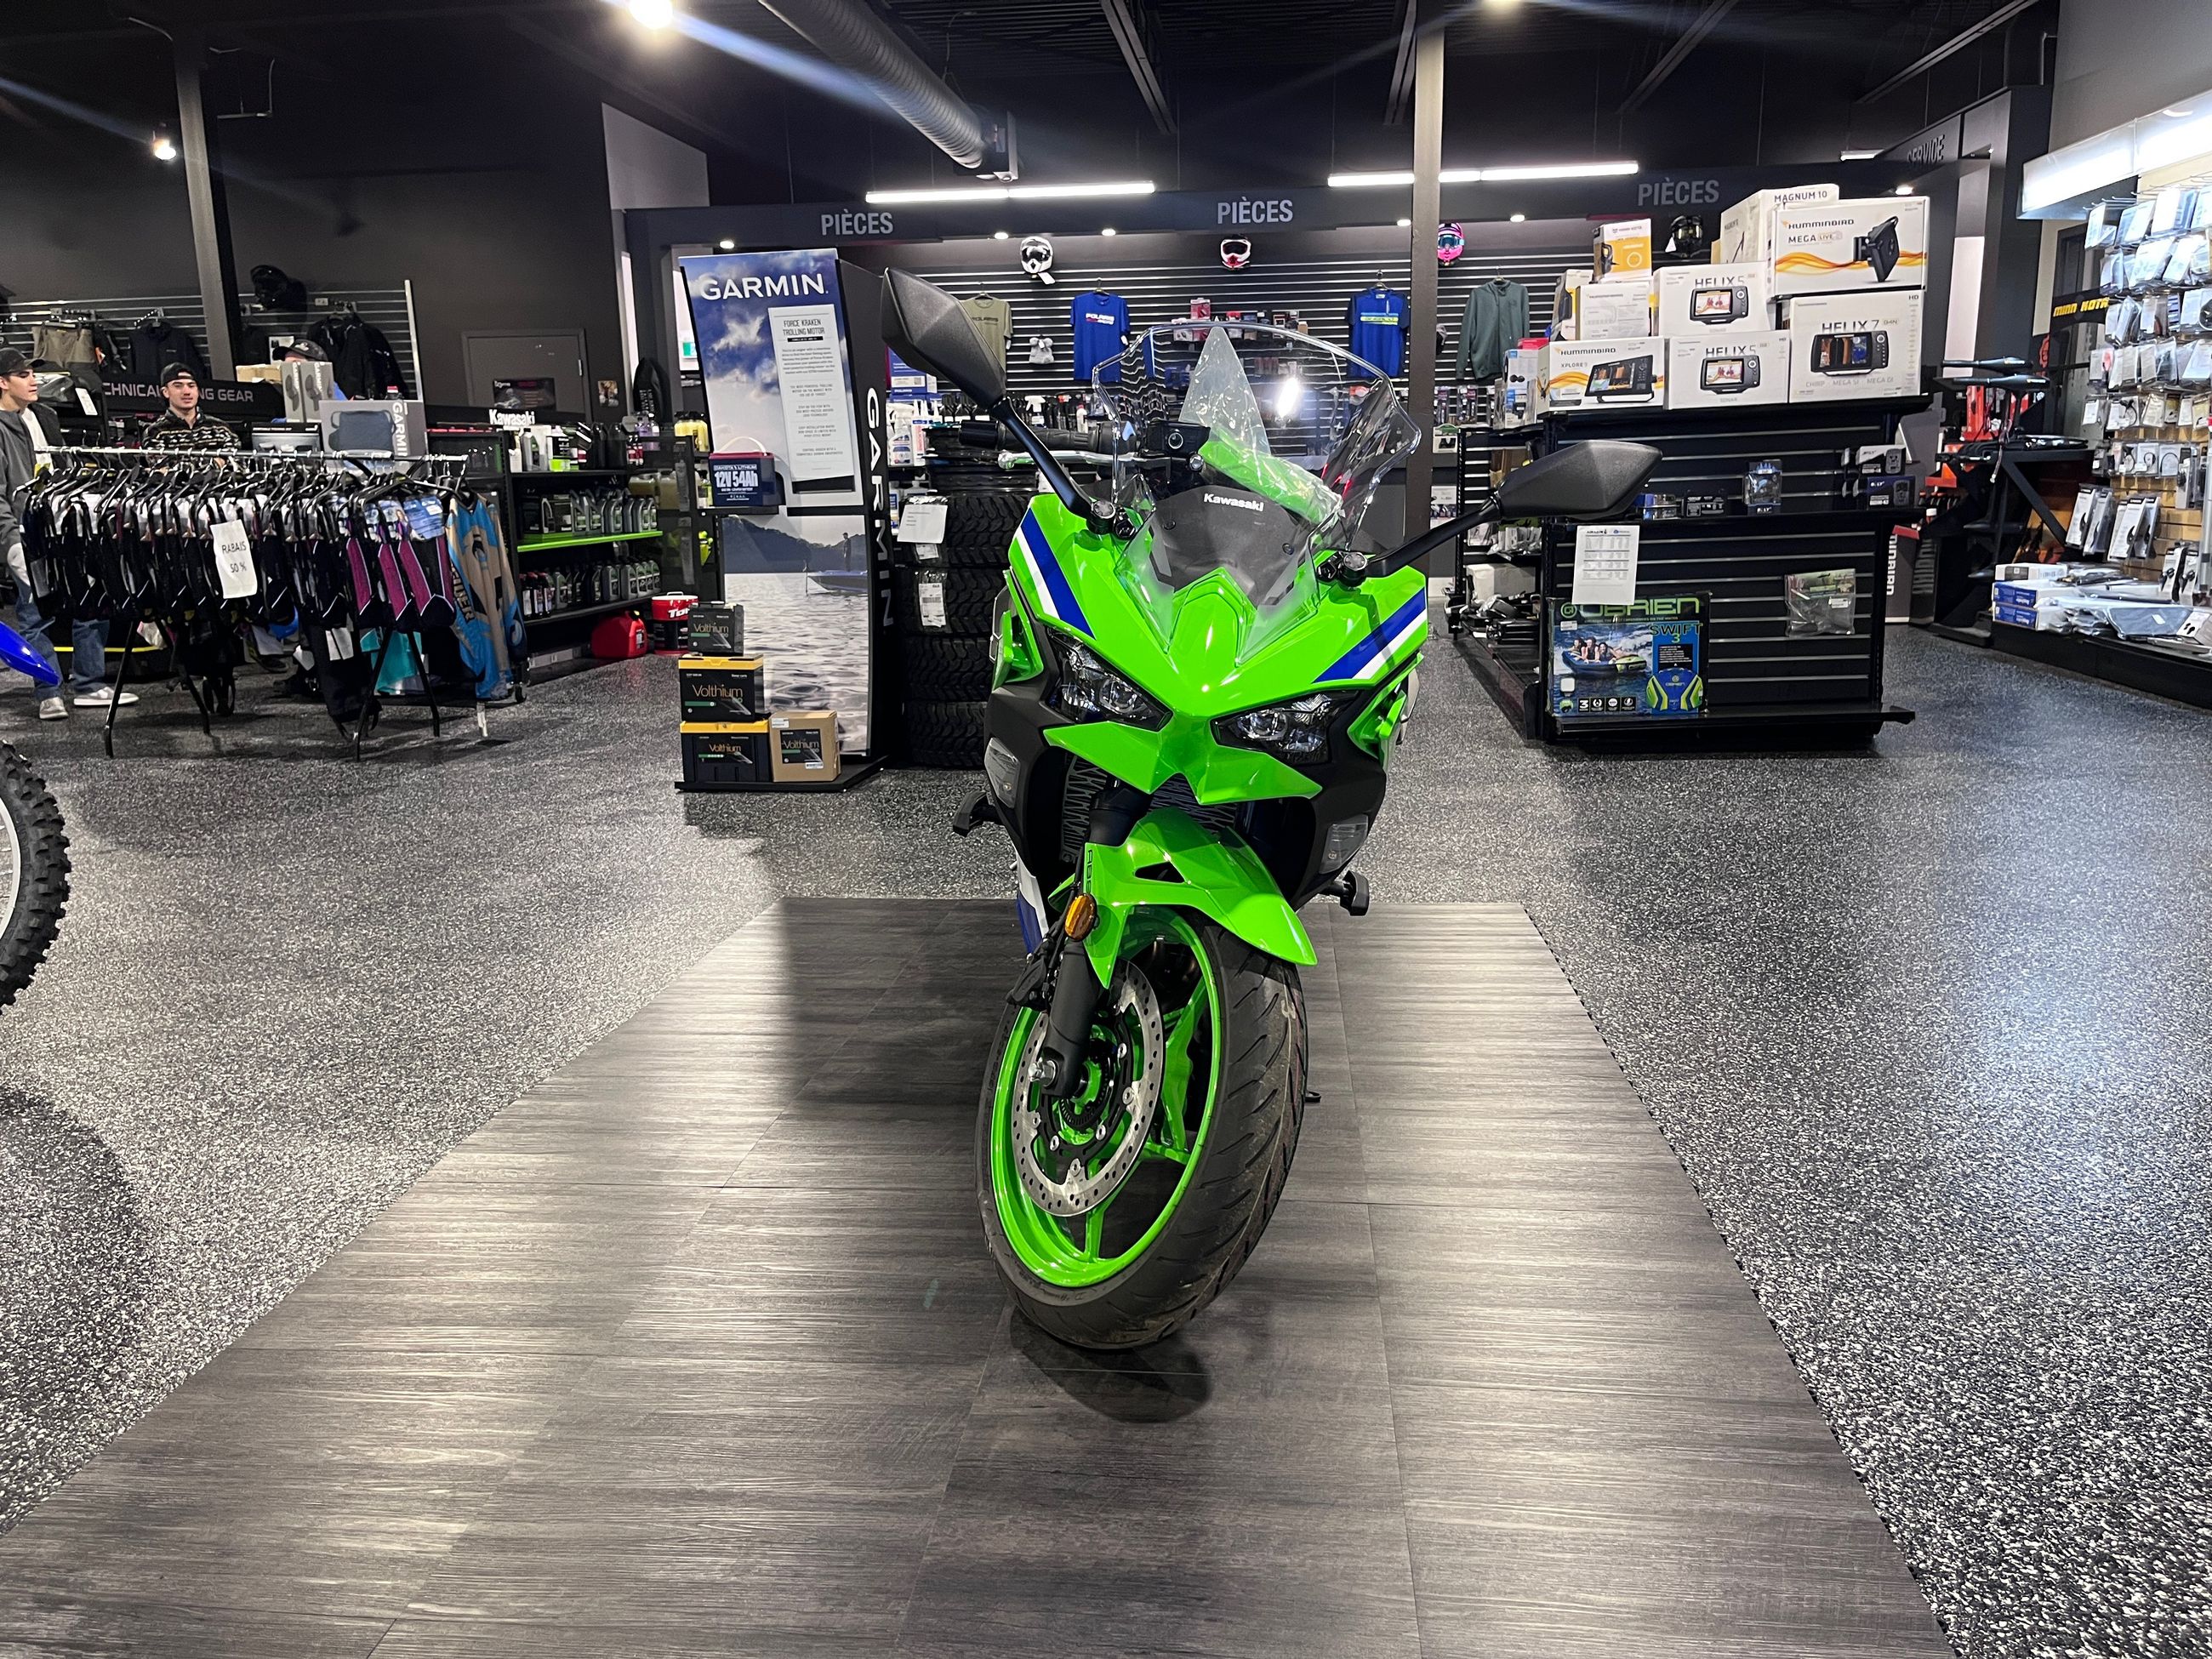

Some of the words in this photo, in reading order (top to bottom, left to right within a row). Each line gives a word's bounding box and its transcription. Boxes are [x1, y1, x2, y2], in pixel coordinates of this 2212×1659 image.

[1638, 177, 1719, 206] PIÈCES
[1775, 191, 1816, 203] MAGNUM
[1818, 191, 1827, 199] 10
[1217, 196, 1293, 224] PIÈCES
[821, 208, 893, 236] PIÈCES
[1788, 219, 1855, 229] HUMMINBIRD
[1787, 235, 1816, 244] MEGA
[699, 273, 825, 300] GARMIN
[801, 318, 822, 327] KRAKEN
[783, 328, 807, 336] TROLLING
[1560, 347, 1616, 356] HUMMINBIRD
[218, 388, 254, 402] GEAR
[488, 408, 536, 426] Kawasaki
[715, 470, 732, 487] 12V
[733, 470, 759, 487] 54Ah
[867, 387, 893, 628] GARMIN
[1203, 493, 1264, 512] Kawasaki
[221, 541, 247, 555] RABAIS
[230, 562, 239, 573] 50
[240, 562, 247, 572] %
[693, 622, 729, 633] Volthium
[1649, 623, 1703, 636] SWIFT
[1672, 633, 1680, 643] 3
[692, 684, 744, 698] Volthium
[1579, 699, 1589, 709] 3
[709, 744, 742, 753] Volthium
[783, 738, 820, 750] Volthium
